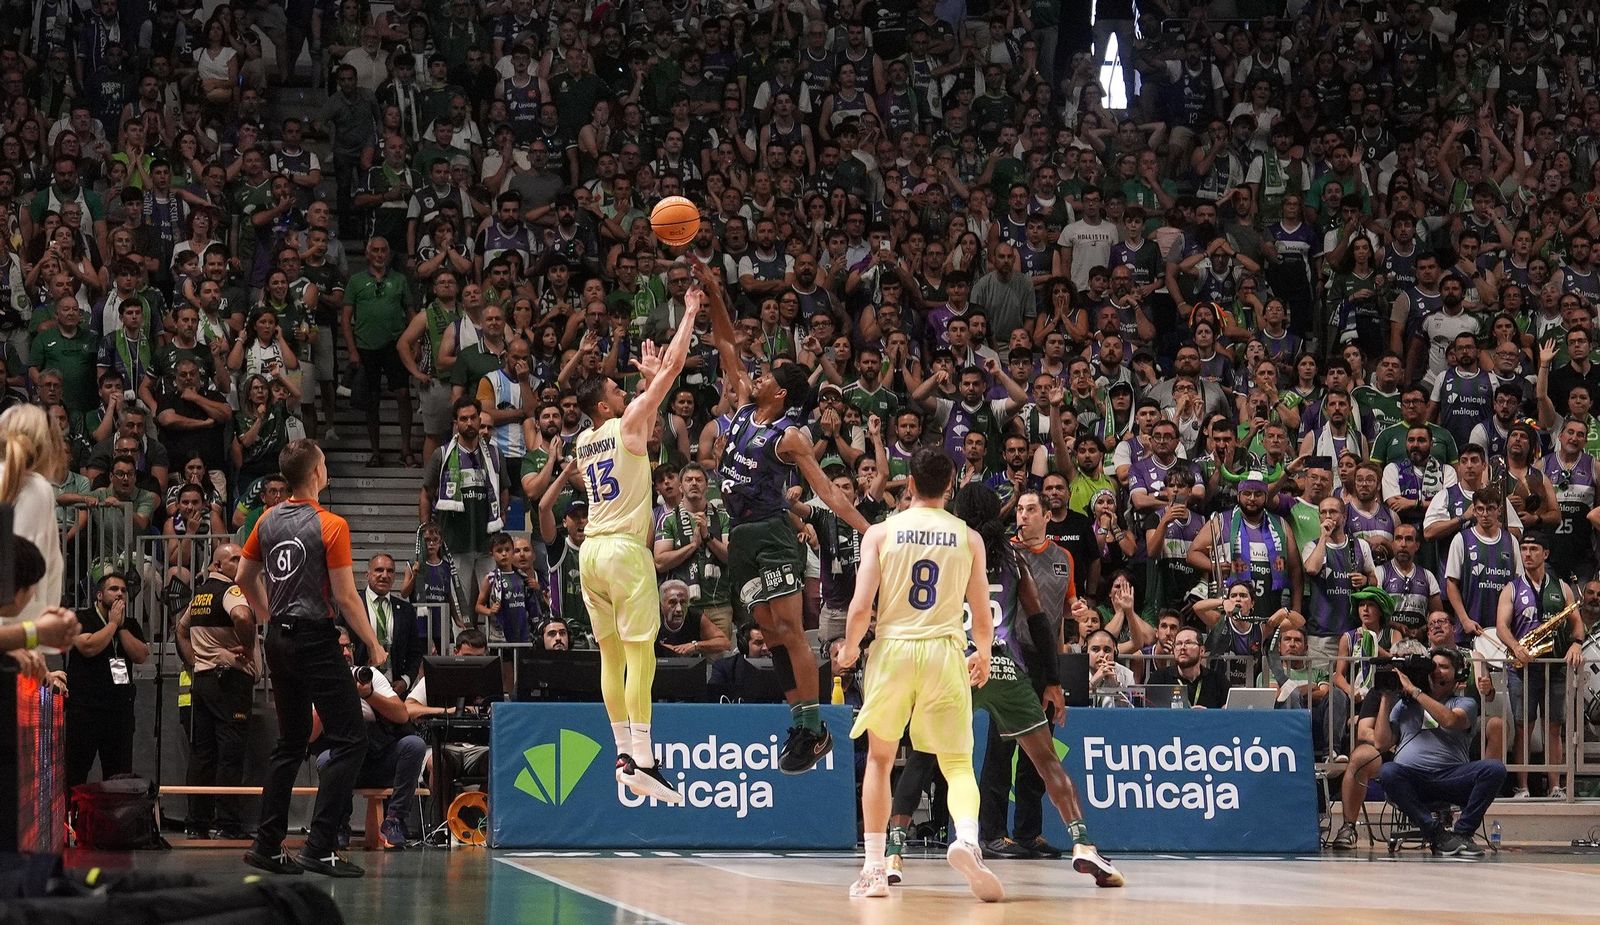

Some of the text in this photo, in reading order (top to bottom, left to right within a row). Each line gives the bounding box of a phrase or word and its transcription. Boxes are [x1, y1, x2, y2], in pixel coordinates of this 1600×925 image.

[1368, 147, 1376, 158] 9
[1460, 395, 1486, 405] Unicaja
[1452, 408, 1480, 417] málaga
[587, 458, 621, 503] 13
[1555, 518, 1574, 535] 25
[896, 530, 957, 547] BRIZUELA
[277, 549, 292, 572] 61
[1485, 566, 1511, 577] Unicaja
[908, 559, 940, 611] 8
[1083, 736, 1297, 772] Fundación
[1086, 773, 1240, 820] Unicaja
